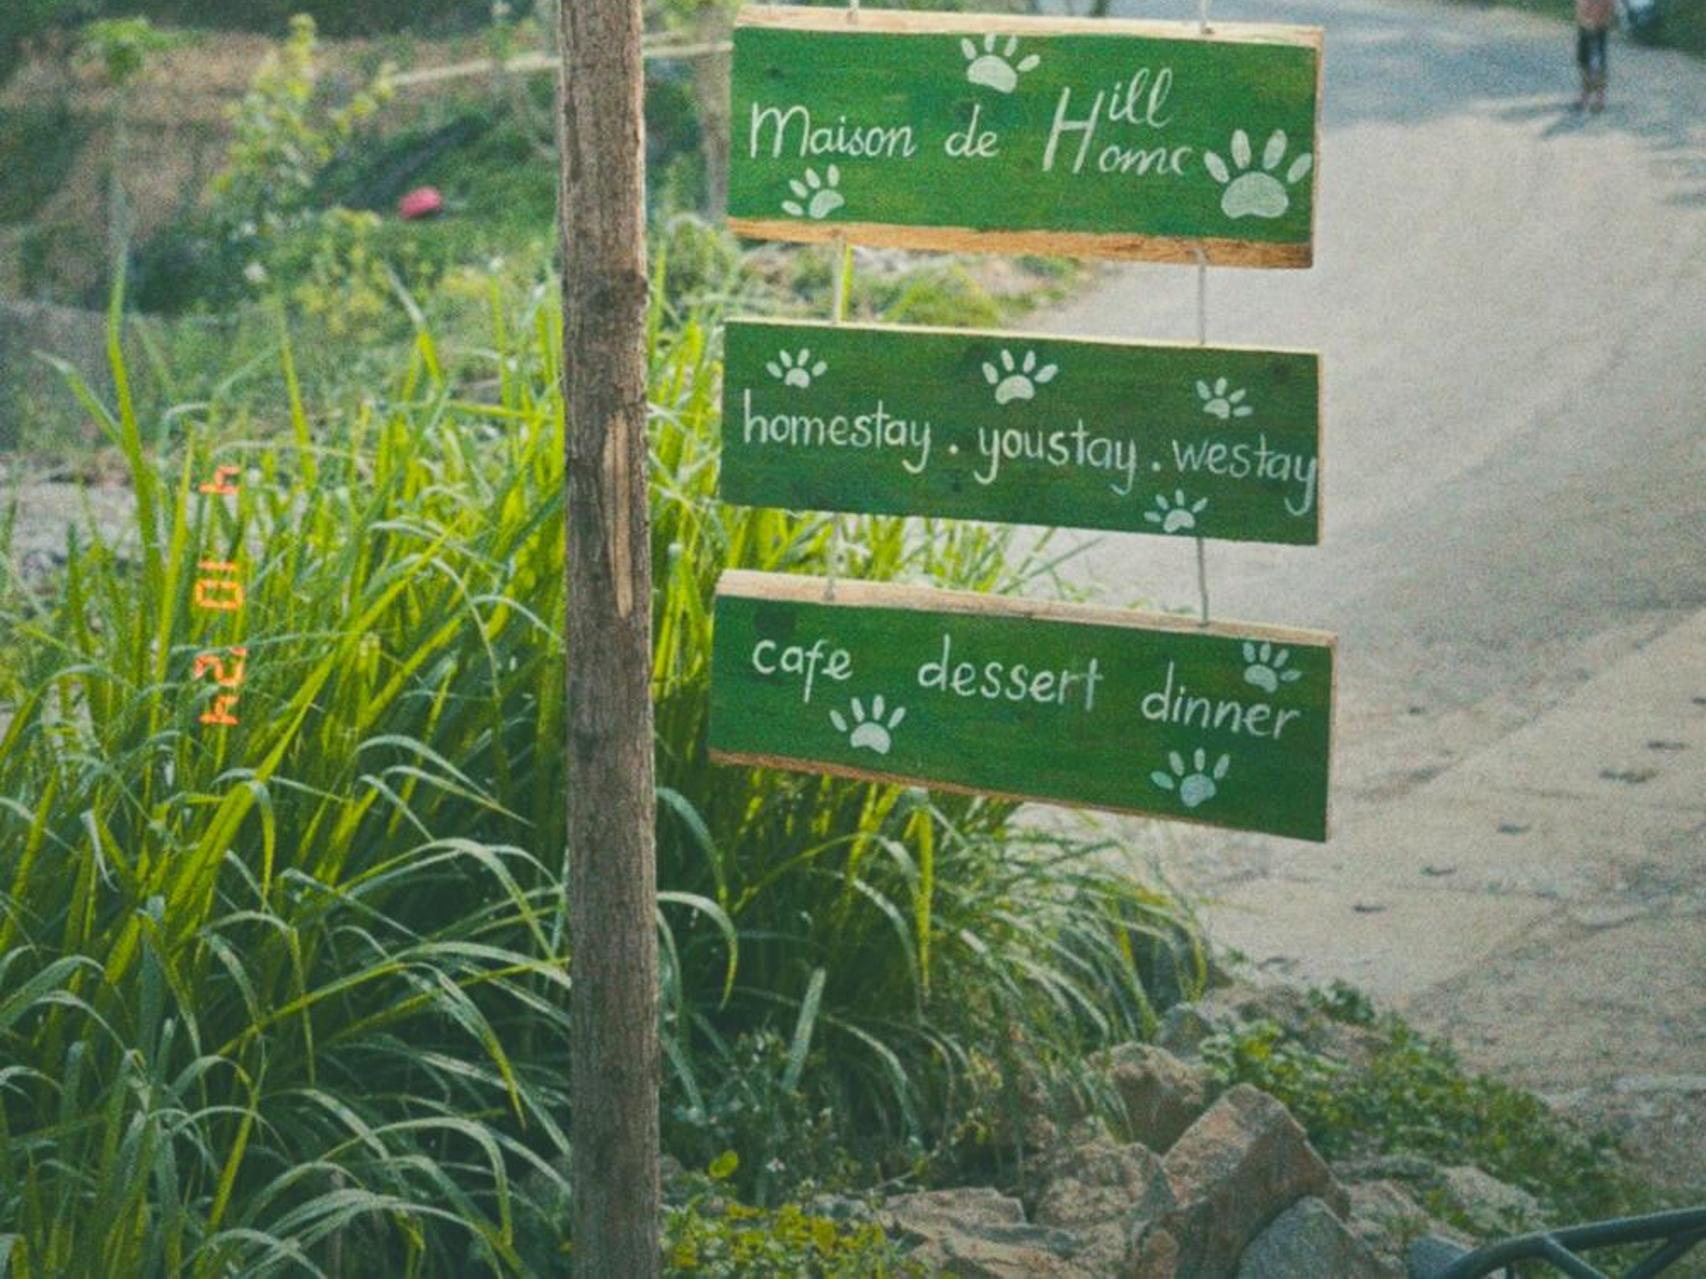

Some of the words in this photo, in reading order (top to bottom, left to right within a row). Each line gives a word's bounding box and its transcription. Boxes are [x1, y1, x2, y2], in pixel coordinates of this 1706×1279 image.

[945, 104, 1000, 157] de
[744, 388, 931, 475] homestay
[974, 419, 1137, 495] youstay
[1172, 433, 1316, 516] westay
[752, 639, 853, 703] cafe
[917, 635, 1101, 711] dessert
[1141, 661, 1300, 739] dinner
